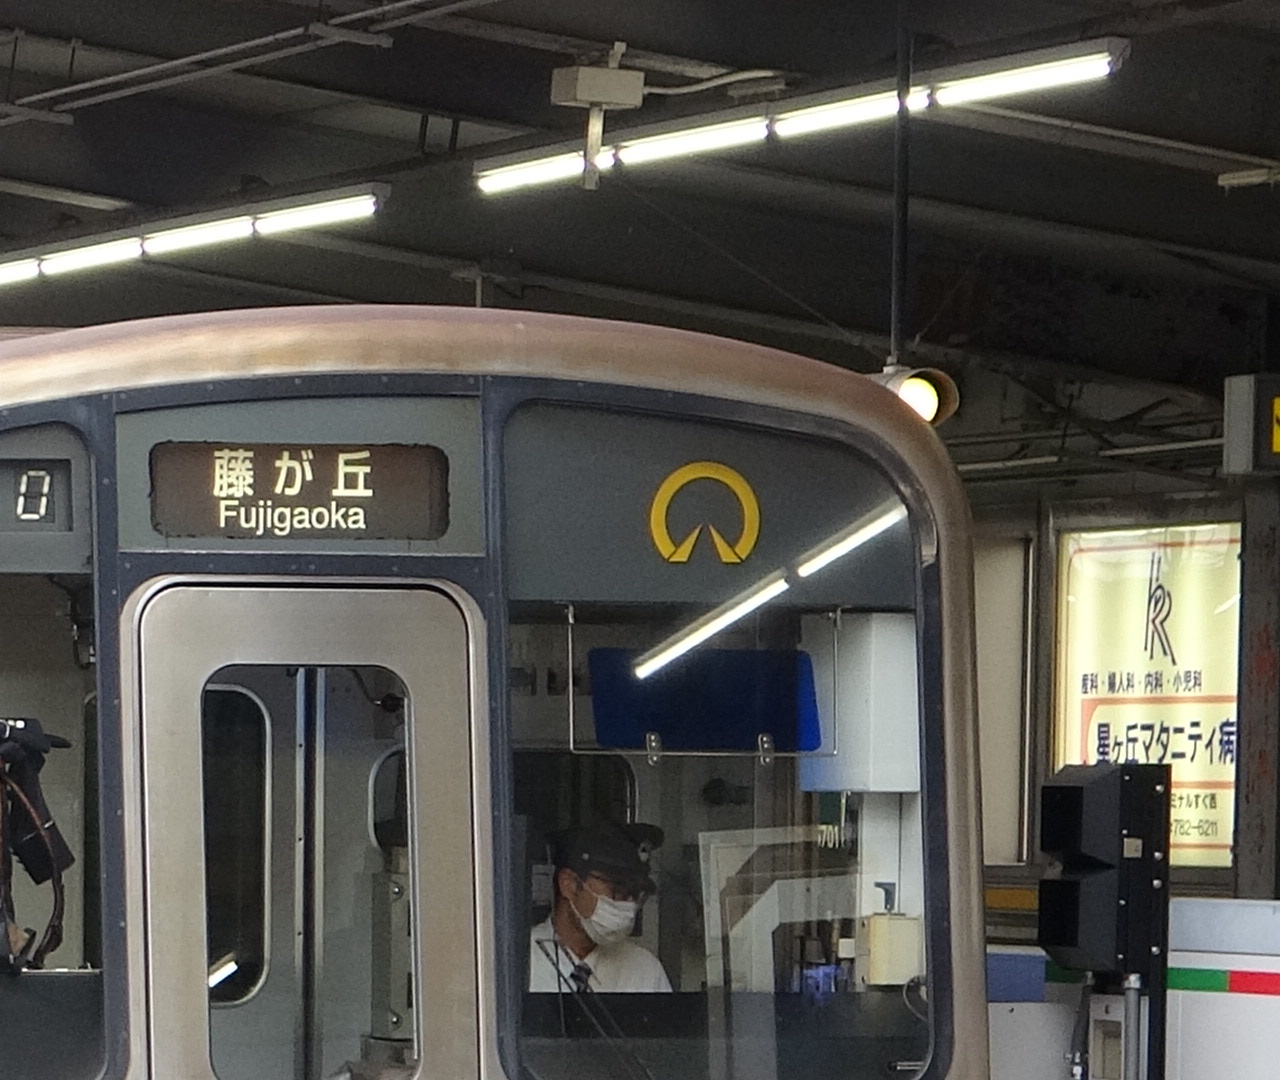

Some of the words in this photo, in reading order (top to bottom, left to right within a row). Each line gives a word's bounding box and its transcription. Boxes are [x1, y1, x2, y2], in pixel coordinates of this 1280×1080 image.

[213, 449, 374, 499] 藤が丘
[219, 499, 367, 536] Fujigaoka
